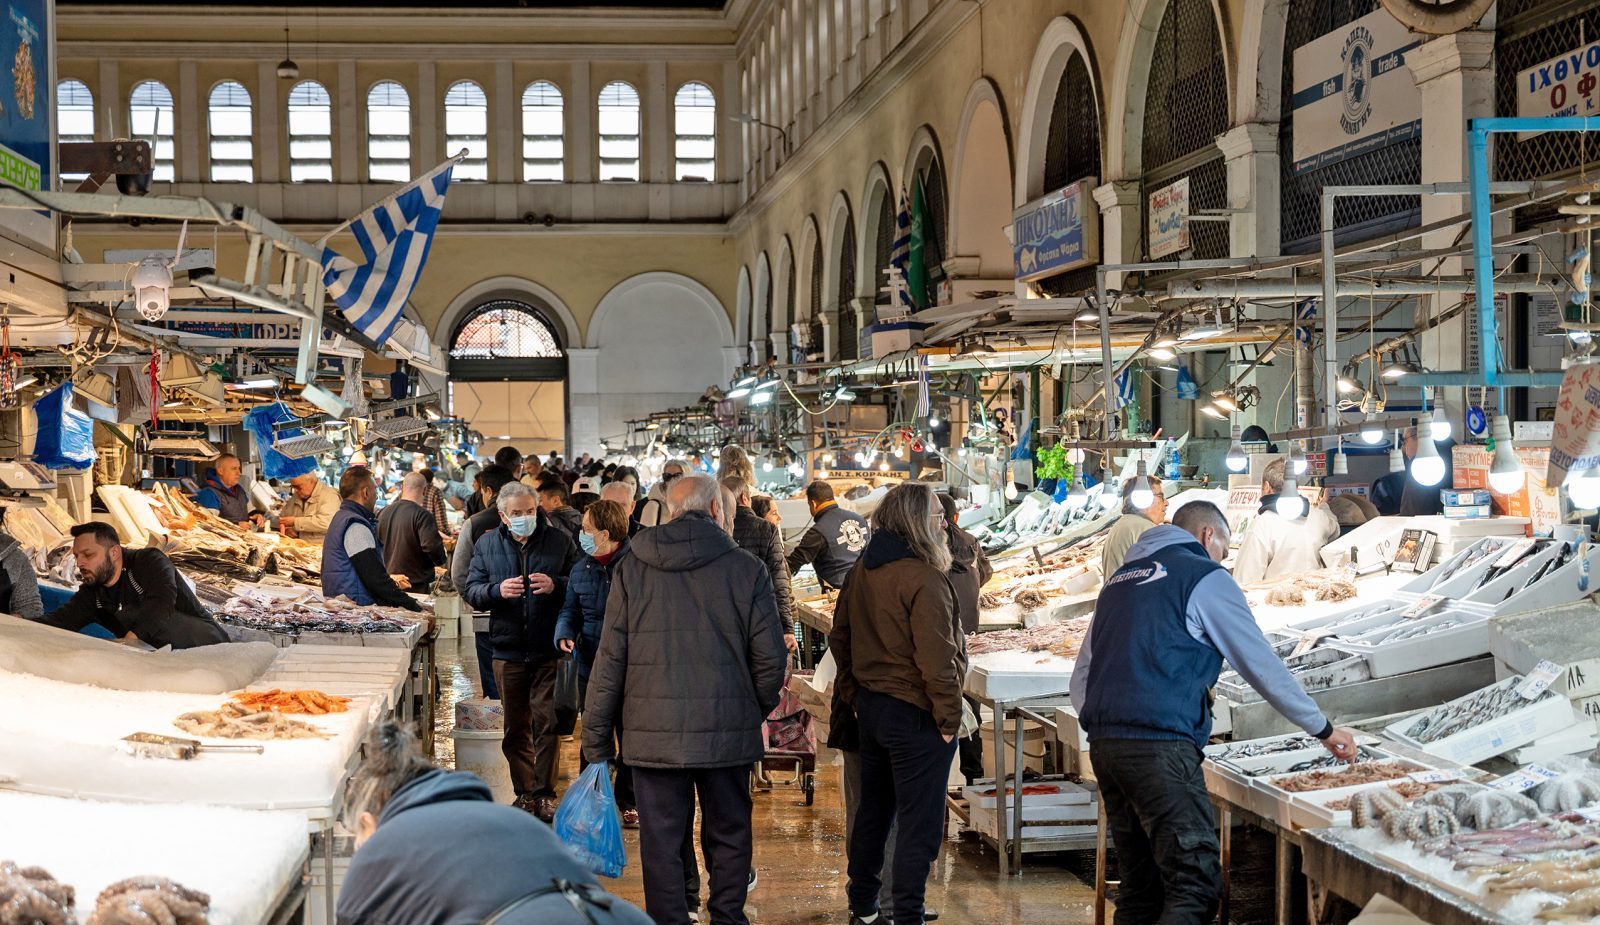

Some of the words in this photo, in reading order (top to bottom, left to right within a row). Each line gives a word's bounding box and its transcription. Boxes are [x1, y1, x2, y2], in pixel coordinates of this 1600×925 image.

[1341, 26, 1374, 61] ΚΑΠΕΤΑΝ
[1322, 79, 1336, 96] fish
[1378, 52, 1399, 73] trade
[1340, 103, 1372, 135] ΠΑΝΑΓΗΣ
[1061, 242, 1079, 256] Ψάρια
[1228, 490, 1260, 505] ΚΑΤΕΨΥ
